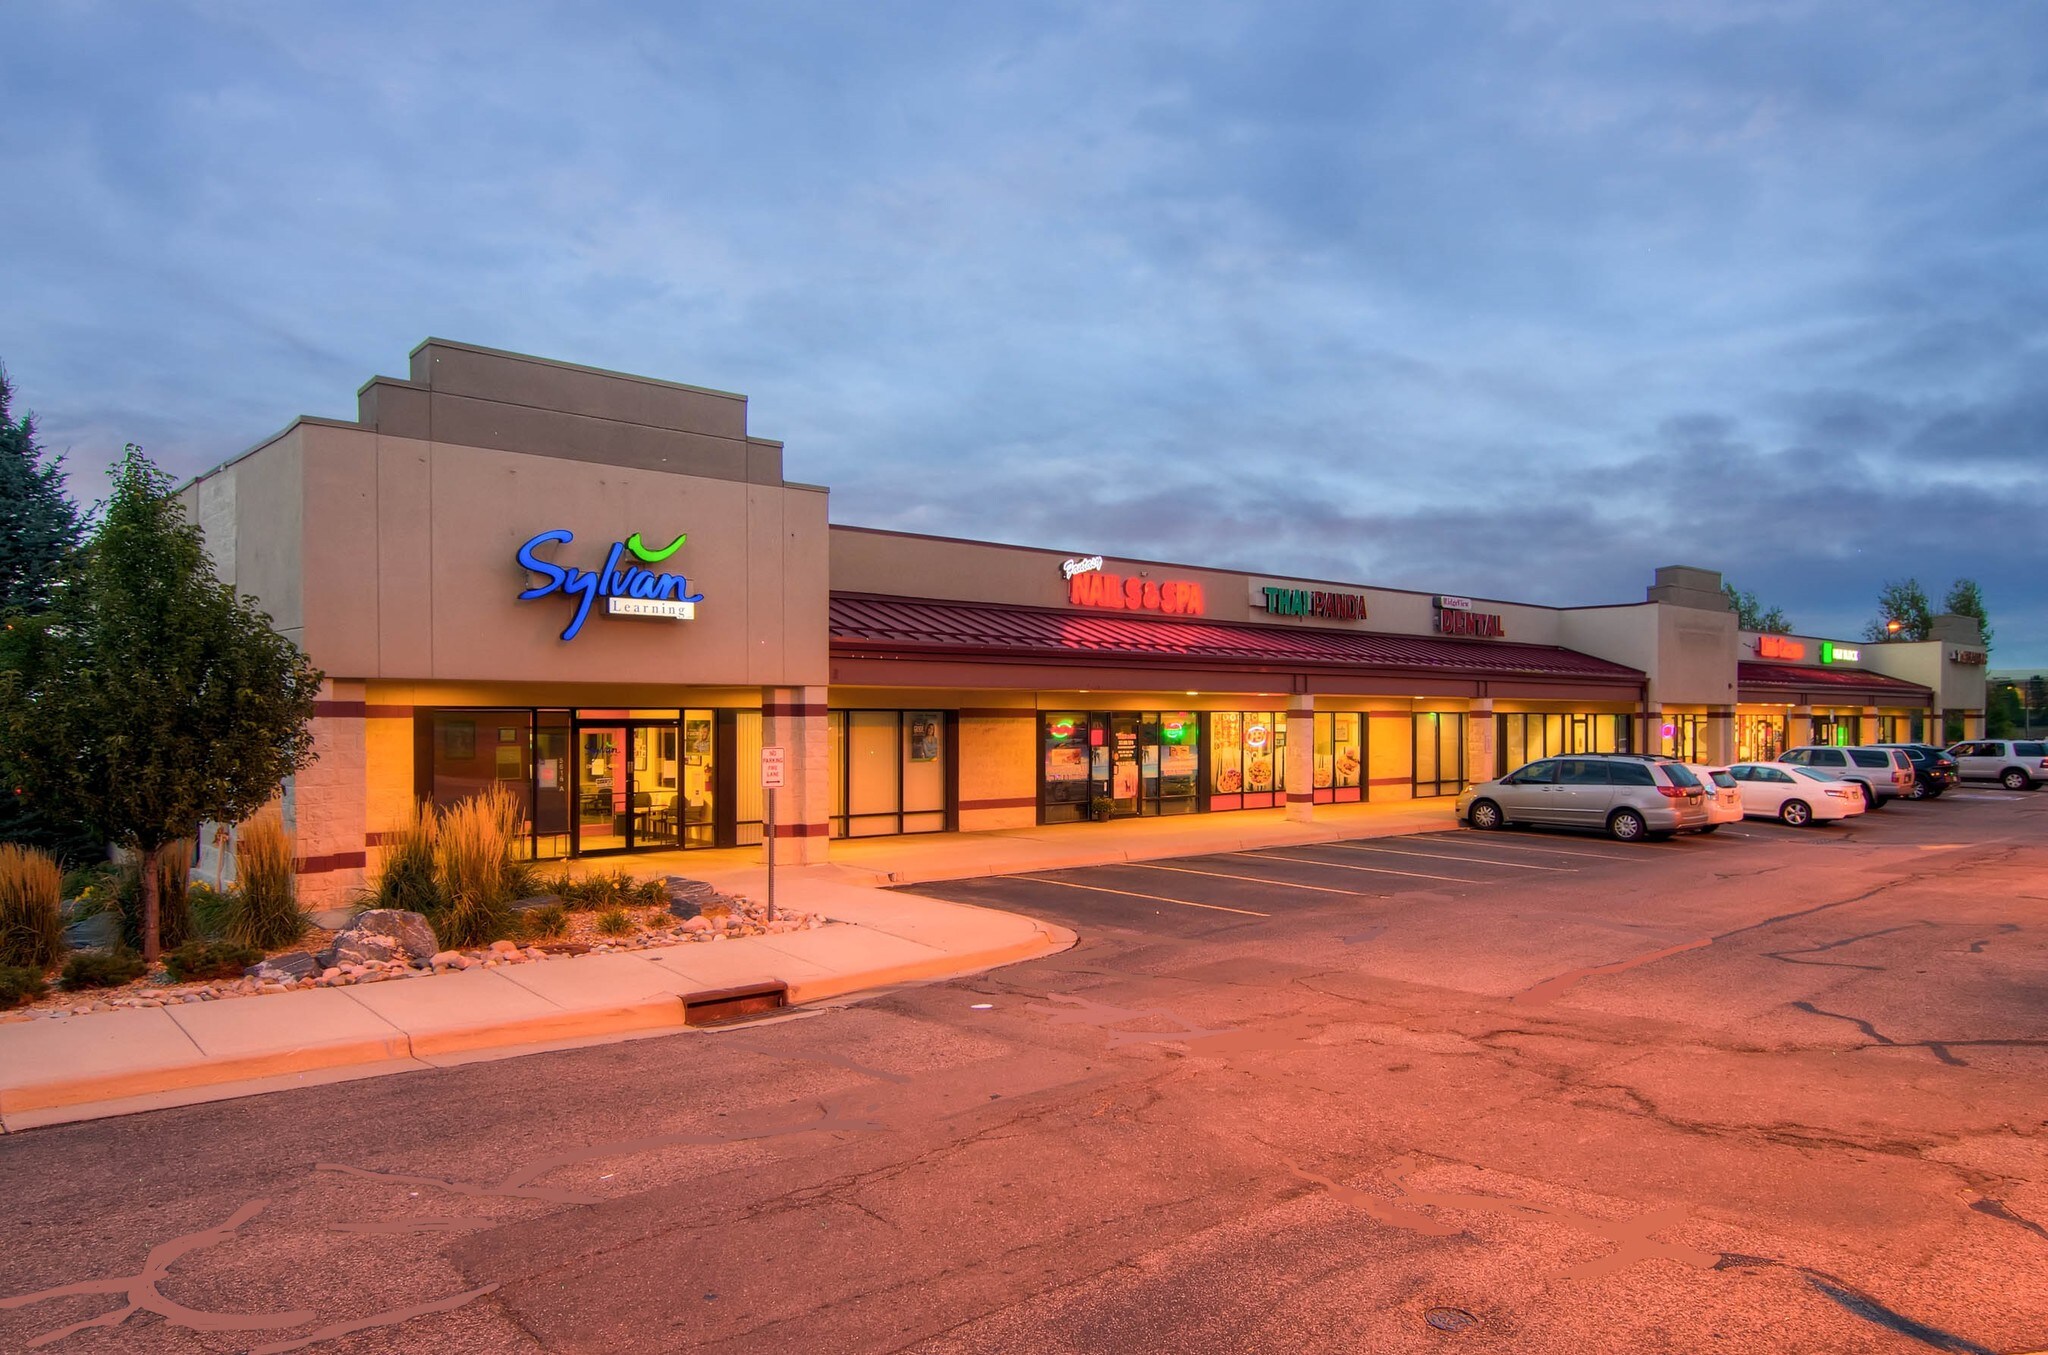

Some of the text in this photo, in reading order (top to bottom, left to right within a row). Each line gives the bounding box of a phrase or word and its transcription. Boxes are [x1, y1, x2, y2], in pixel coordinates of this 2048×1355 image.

[1062, 556, 1103, 580] Fantasy
[517, 530, 704, 641] Sylvan
[1070, 573, 1142, 610] NAILS
[1160, 580, 1204, 615] SPA
[613, 600, 686, 619] Learning
[1264, 587, 1367, 620] THAI PANDA
[1441, 609, 1505, 637] DENTAL
